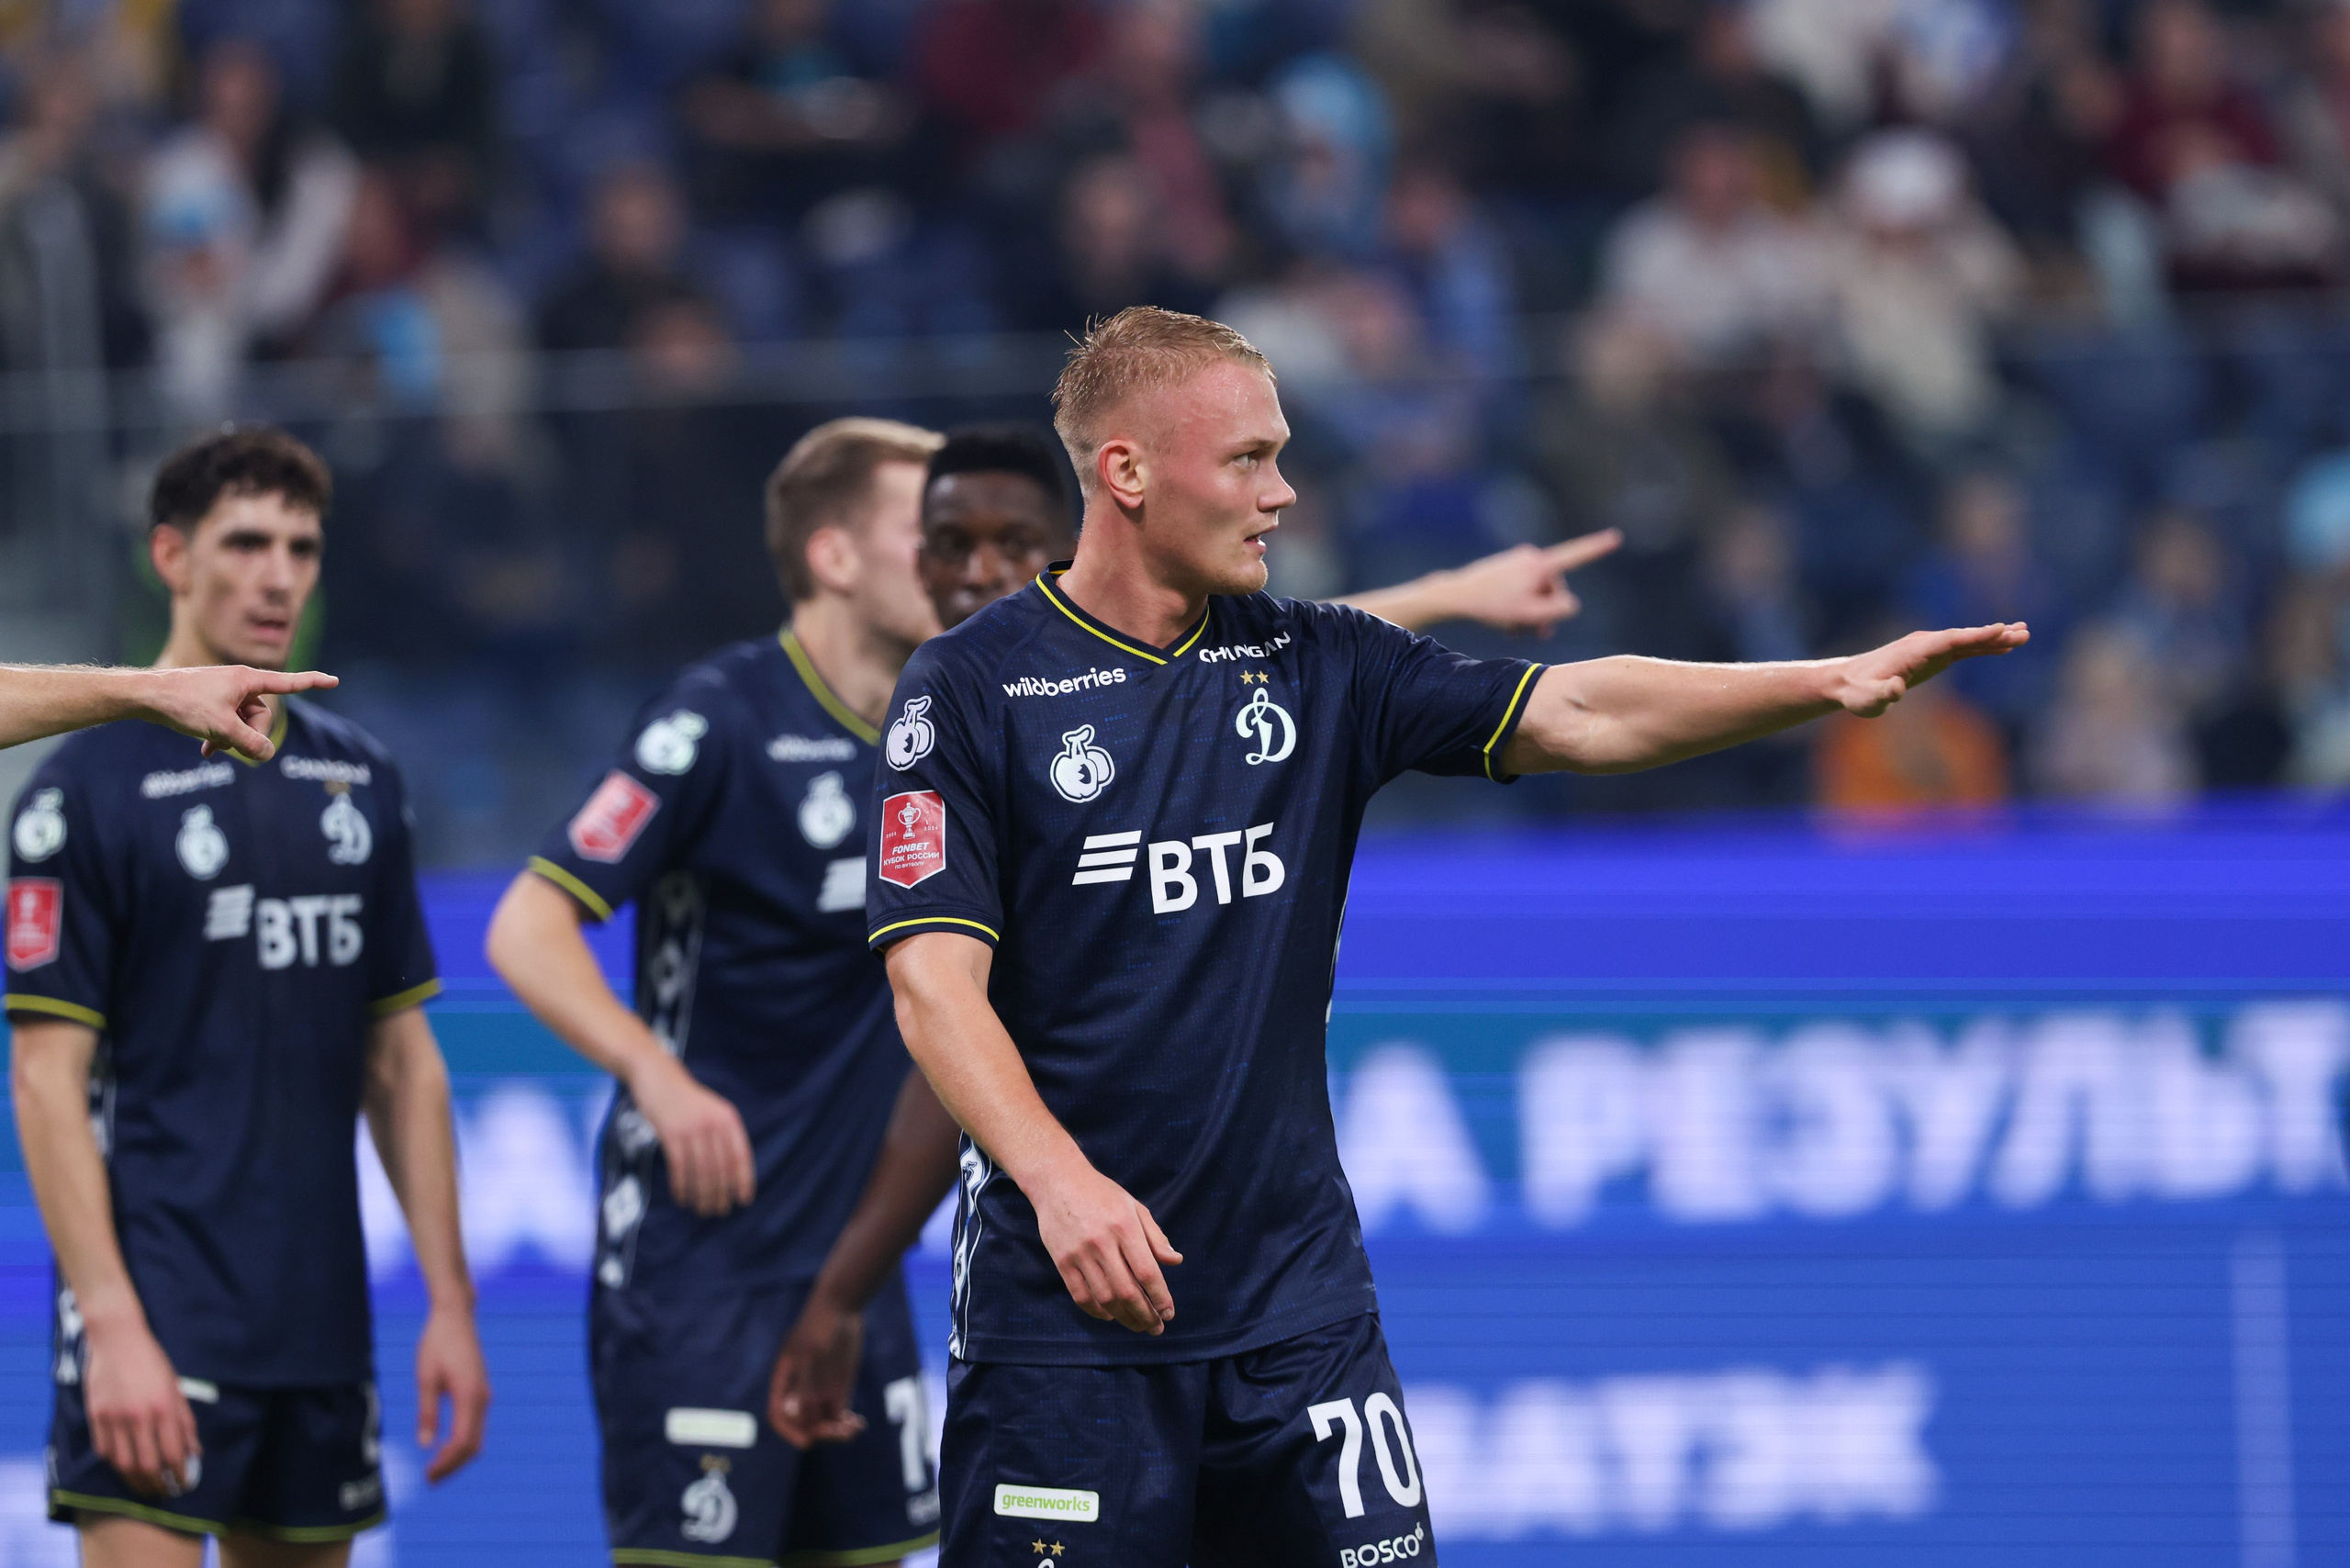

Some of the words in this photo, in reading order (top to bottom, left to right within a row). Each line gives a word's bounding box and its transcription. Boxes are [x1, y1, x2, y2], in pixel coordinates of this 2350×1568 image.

[1002, 666, 1127, 698] wildberries
[883, 855, 905, 867] КУБОК
[907, 852, 940, 861] РОССИИ
[891, 841, 930, 856] FONBET
[1148, 822, 1285, 914] ВТБ
[1516, 1001, 2350, 1230] РЕЗУЛЬТ
[1306, 1392, 1422, 1519] 70
[1002, 1494, 1091, 1512] greenworks
[1339, 1534, 1420, 1568] BOSCO
